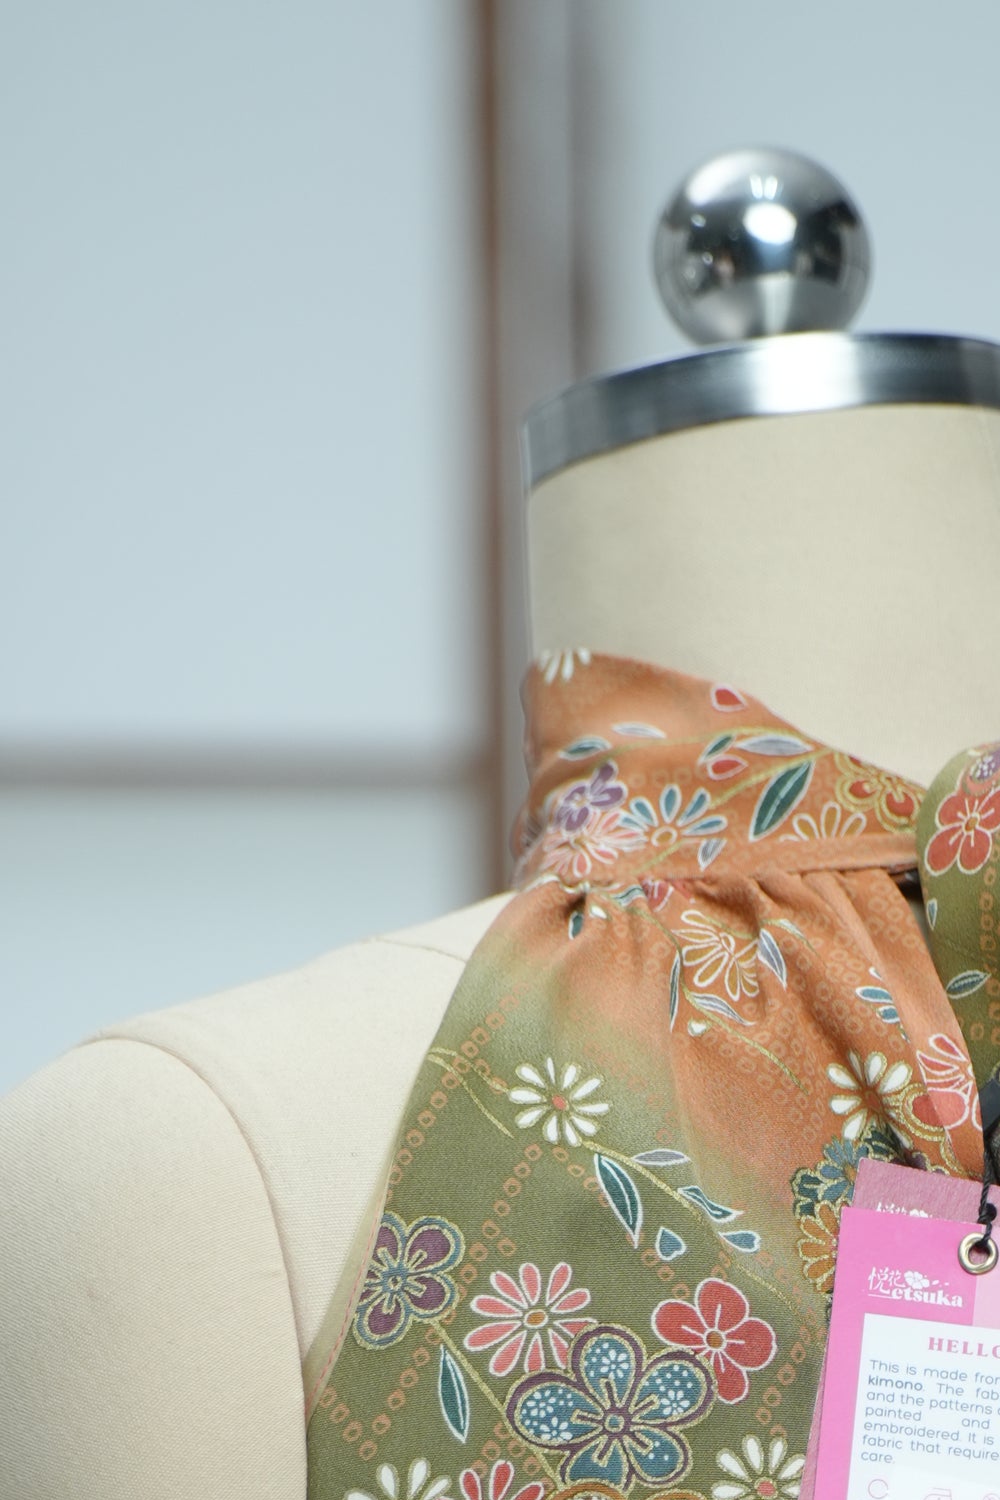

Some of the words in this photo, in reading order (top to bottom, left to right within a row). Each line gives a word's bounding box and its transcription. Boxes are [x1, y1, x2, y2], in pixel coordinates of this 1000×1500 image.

[869, 1359, 900, 1373] This
[906, 1364, 917, 1375] is
[923, 1367, 968, 1381] made
[867, 1374, 925, 1391] kimono.
[937, 1382, 965, 1396] The
[866, 1391, 895, 1403] and
[900, 1393, 925, 1406] the
[929, 1398, 993, 1415] patterns
[864, 1406, 922, 1421] painted
[961, 1418, 990, 1430] and
[862, 1434, 903, 1449] fabric
[910, 1440, 941, 1454] that
[863, 1421, 961, 1442] embroidered.
[968, 1432, 976, 1444] It
[983, 1435, 994, 1445] is
[860, 1451, 895, 1465] care.
